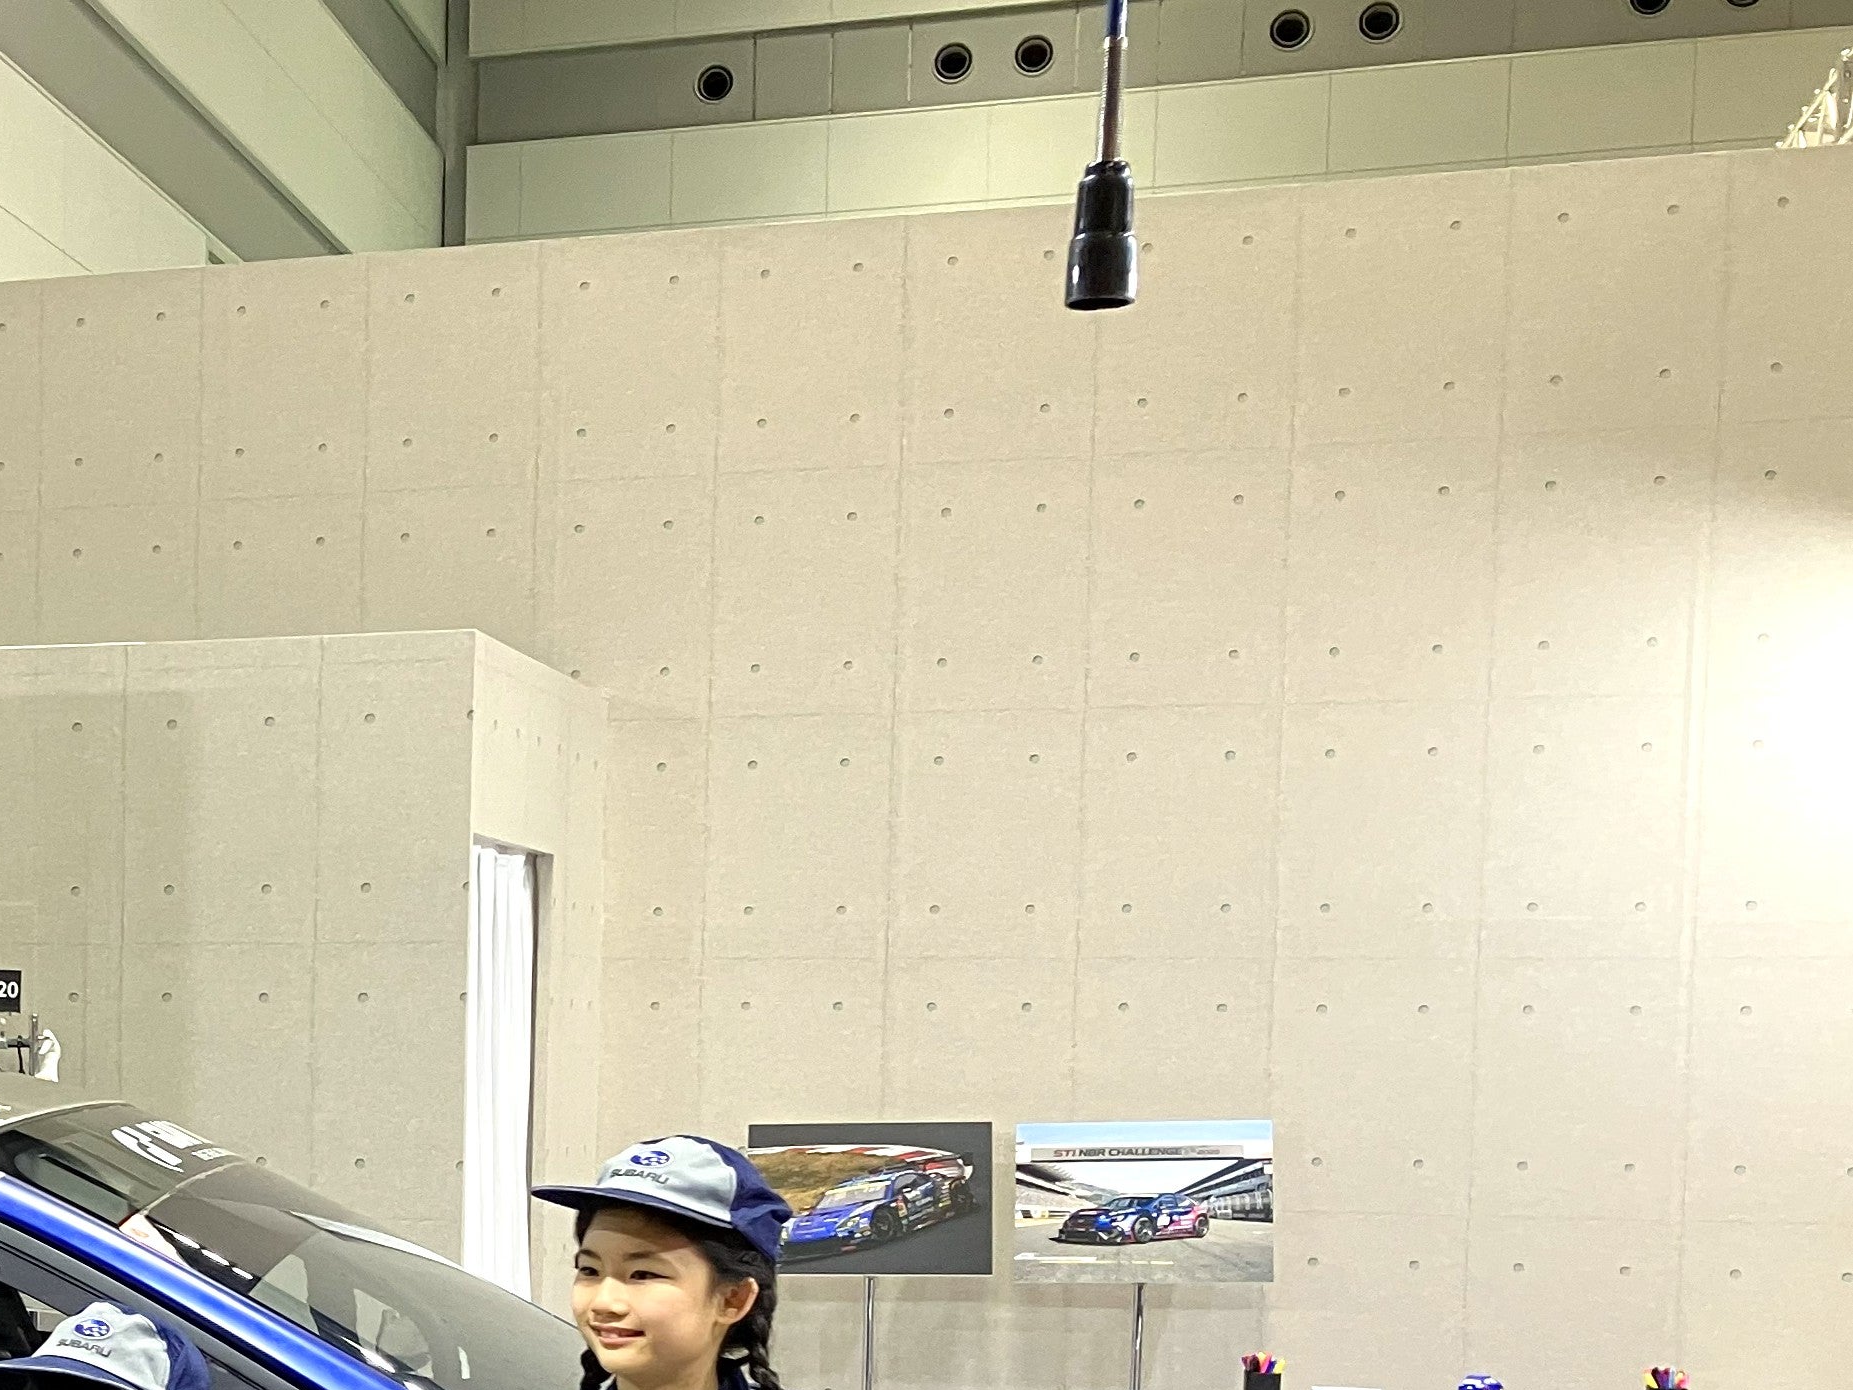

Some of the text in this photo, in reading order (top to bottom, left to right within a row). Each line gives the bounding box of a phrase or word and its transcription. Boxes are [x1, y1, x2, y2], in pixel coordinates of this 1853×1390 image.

[1108, 1147, 1182, 1156] CHALLENGE
[610, 1168, 669, 1184] SUBARU
[56, 1338, 113, 1358] SUBARU
